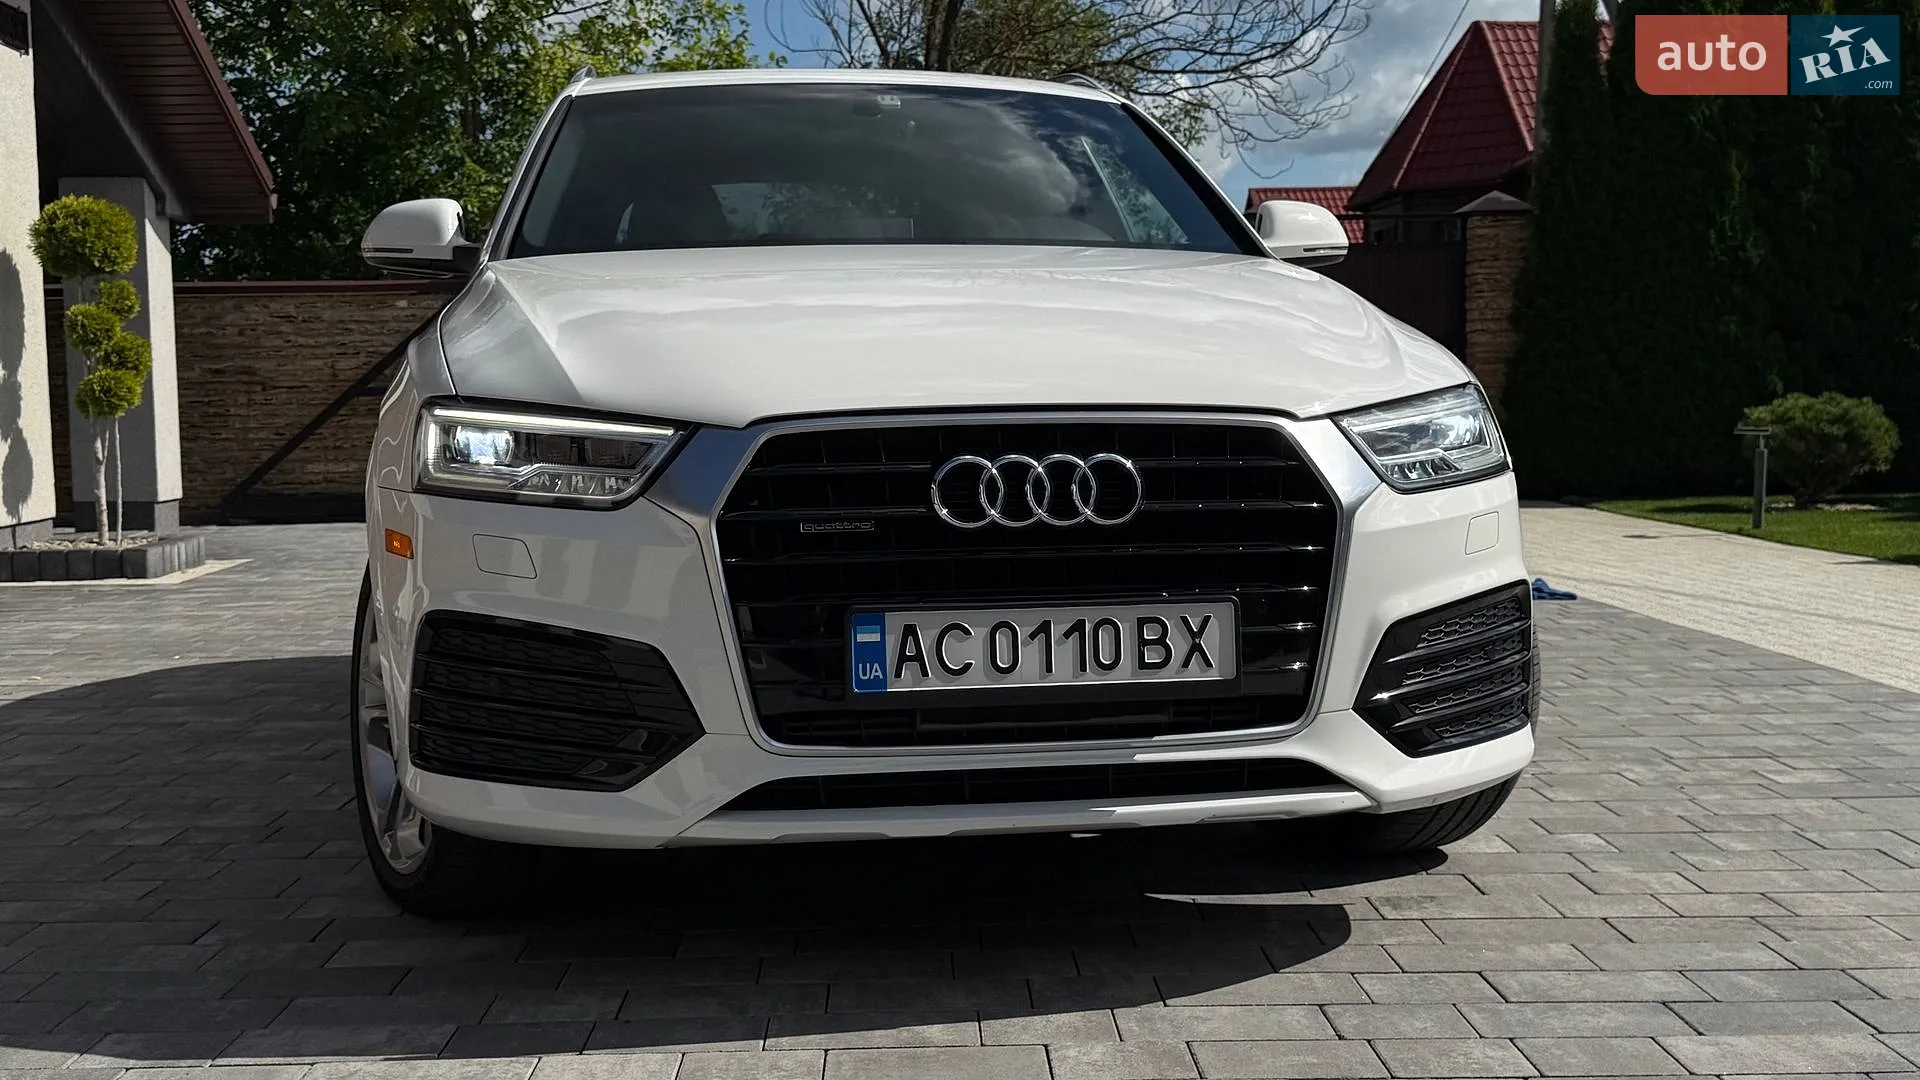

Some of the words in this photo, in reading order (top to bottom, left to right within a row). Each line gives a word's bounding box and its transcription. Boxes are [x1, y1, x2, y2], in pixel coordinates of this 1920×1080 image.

[803, 521, 872, 532] quattro
[893, 621, 976, 679] AC
[987, 617, 1124, 675] 0110
[1136, 612, 1216, 671] BX
[858, 662, 884, 681] UA
